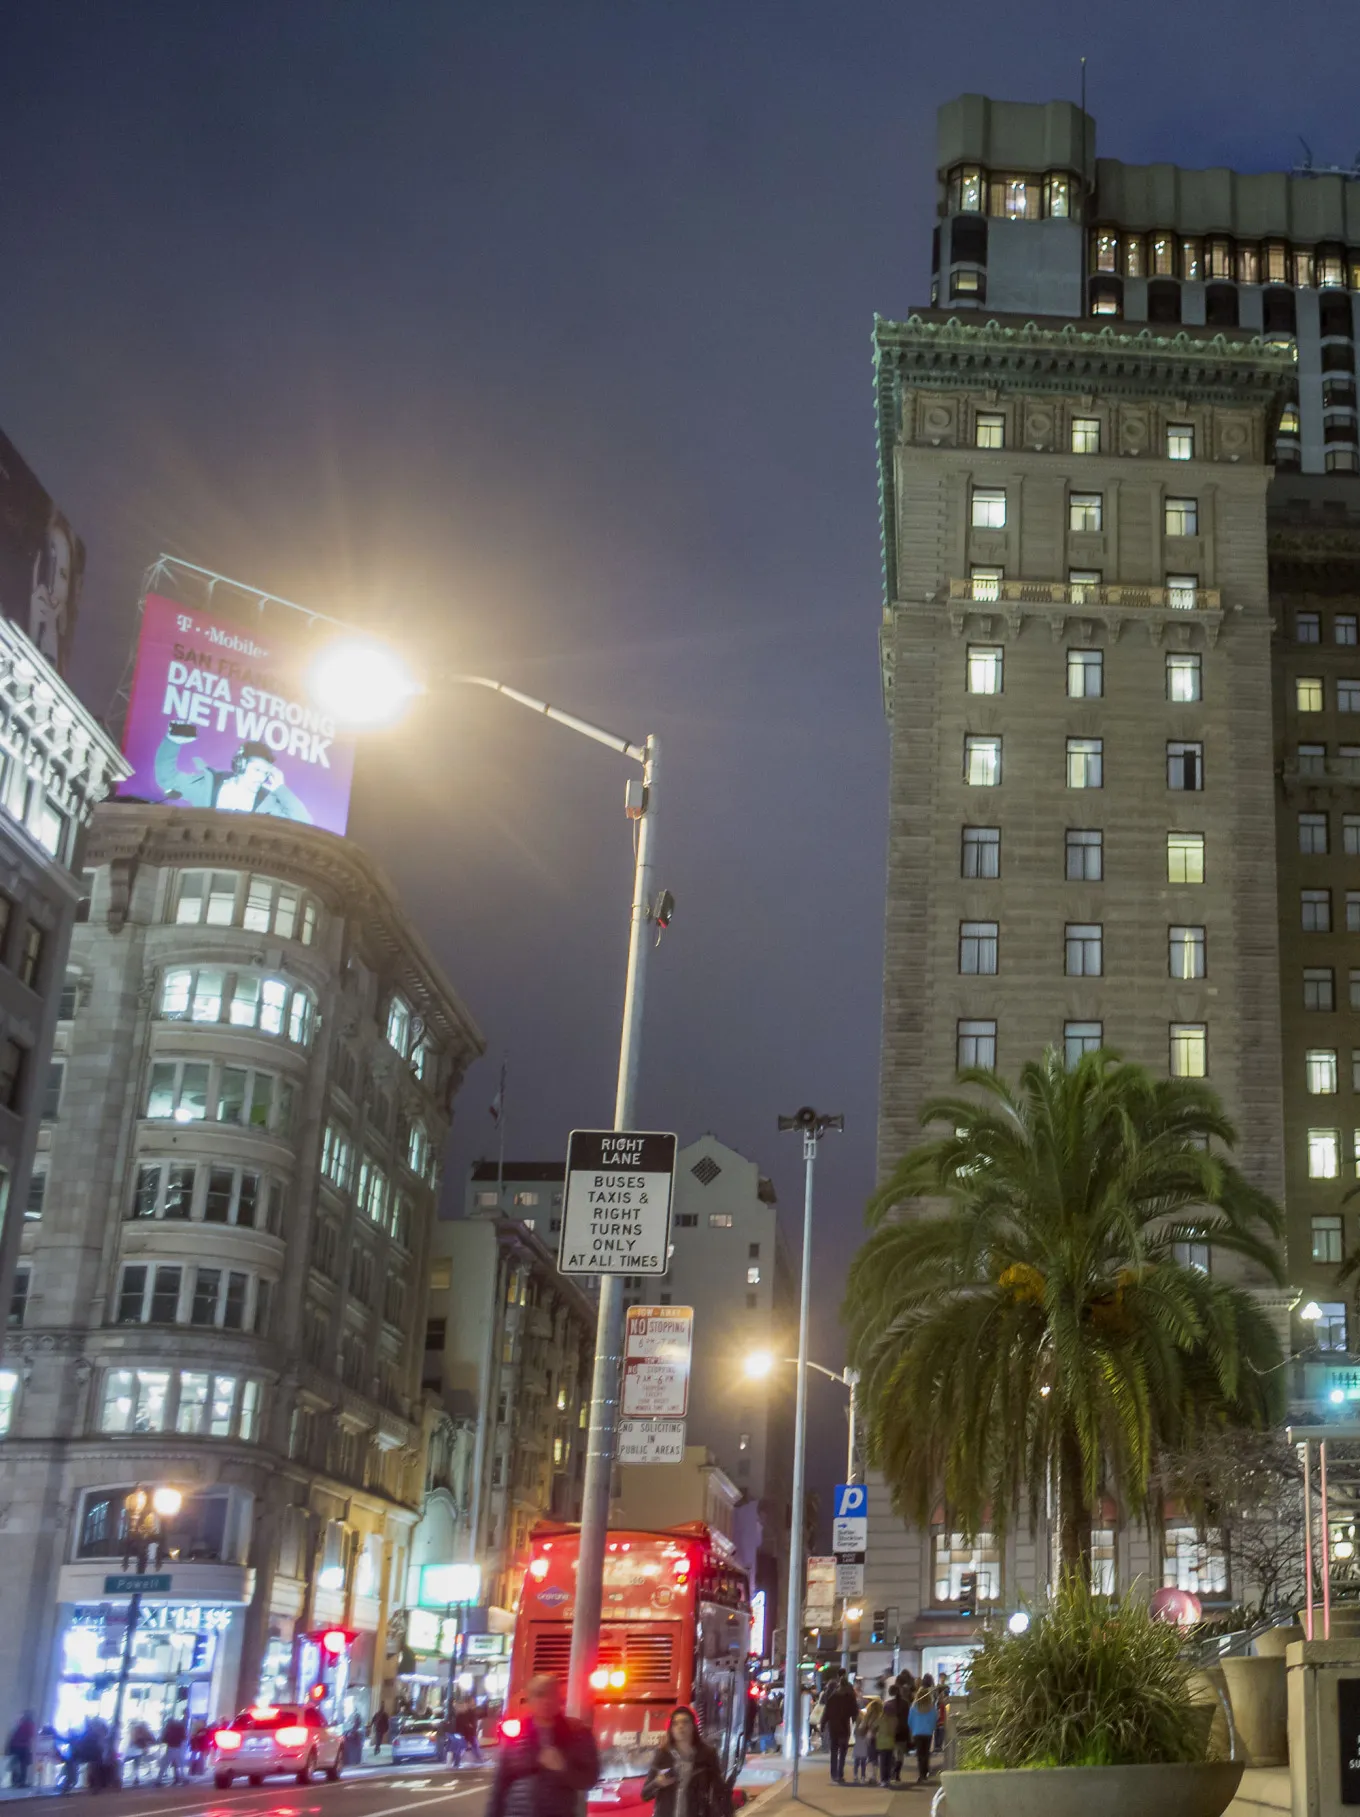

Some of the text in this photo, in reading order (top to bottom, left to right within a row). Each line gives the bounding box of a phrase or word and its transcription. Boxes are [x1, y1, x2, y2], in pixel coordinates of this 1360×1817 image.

[173, 644, 212, 668] SAN
[168, 661, 335, 738] DATA STRONG
[162, 684, 331, 769] NETWORK
[601, 1138, 645, 1152] RIGHT
[602, 1153, 641, 1165] LANE
[594, 1176, 646, 1188] BUSES
[588, 1191, 649, 1204] TAXIS &
[593, 1208, 641, 1220] RIGHT
[590, 1223, 643, 1236] TURNS
[593, 1238, 637, 1251] ONLY
[568, 1254, 586, 1266] AT
[620, 1255, 658, 1268] TIMES
[630, 1318, 685, 1335] NO STOPPING
[640, 1424, 681, 1433] SOLICITING
[647, 1435, 656, 1444] IN
[620, 1445, 681, 1455] PUBLIC AREAS
[116, 1579, 160, 1589] Powell
